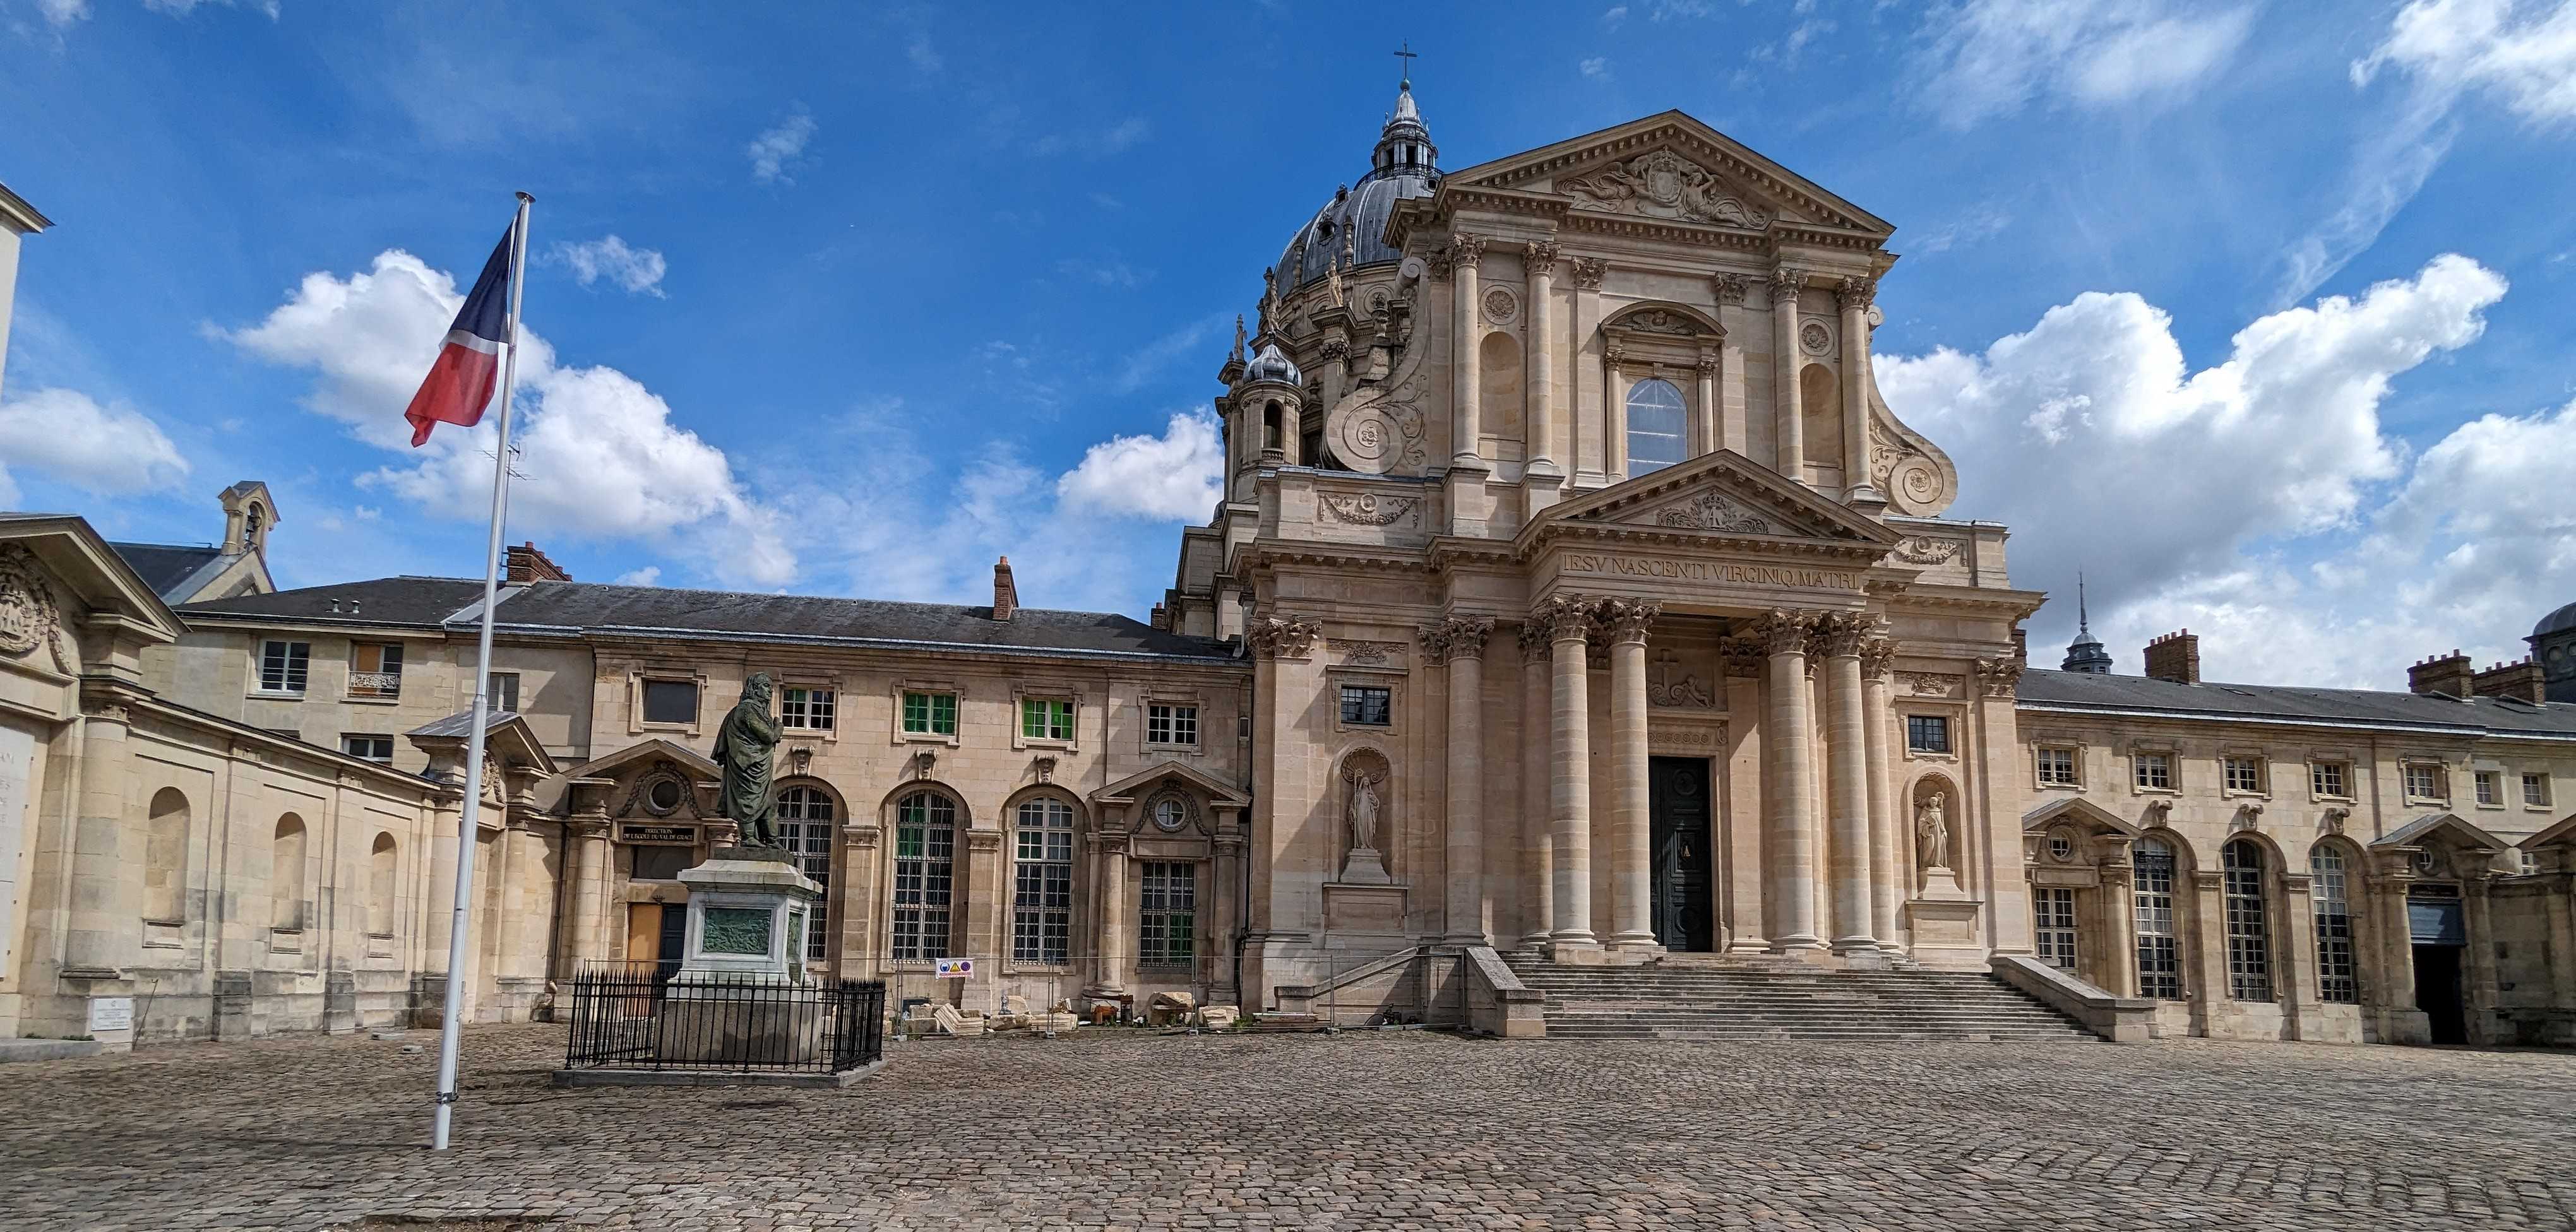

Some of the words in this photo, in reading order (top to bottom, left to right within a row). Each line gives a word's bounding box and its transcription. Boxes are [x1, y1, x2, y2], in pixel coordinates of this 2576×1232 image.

[1563, 554, 1607, 572] IESV
[1611, 557, 1708, 580] NASCENTI
[1798, 570, 1859, 589] MATRI
